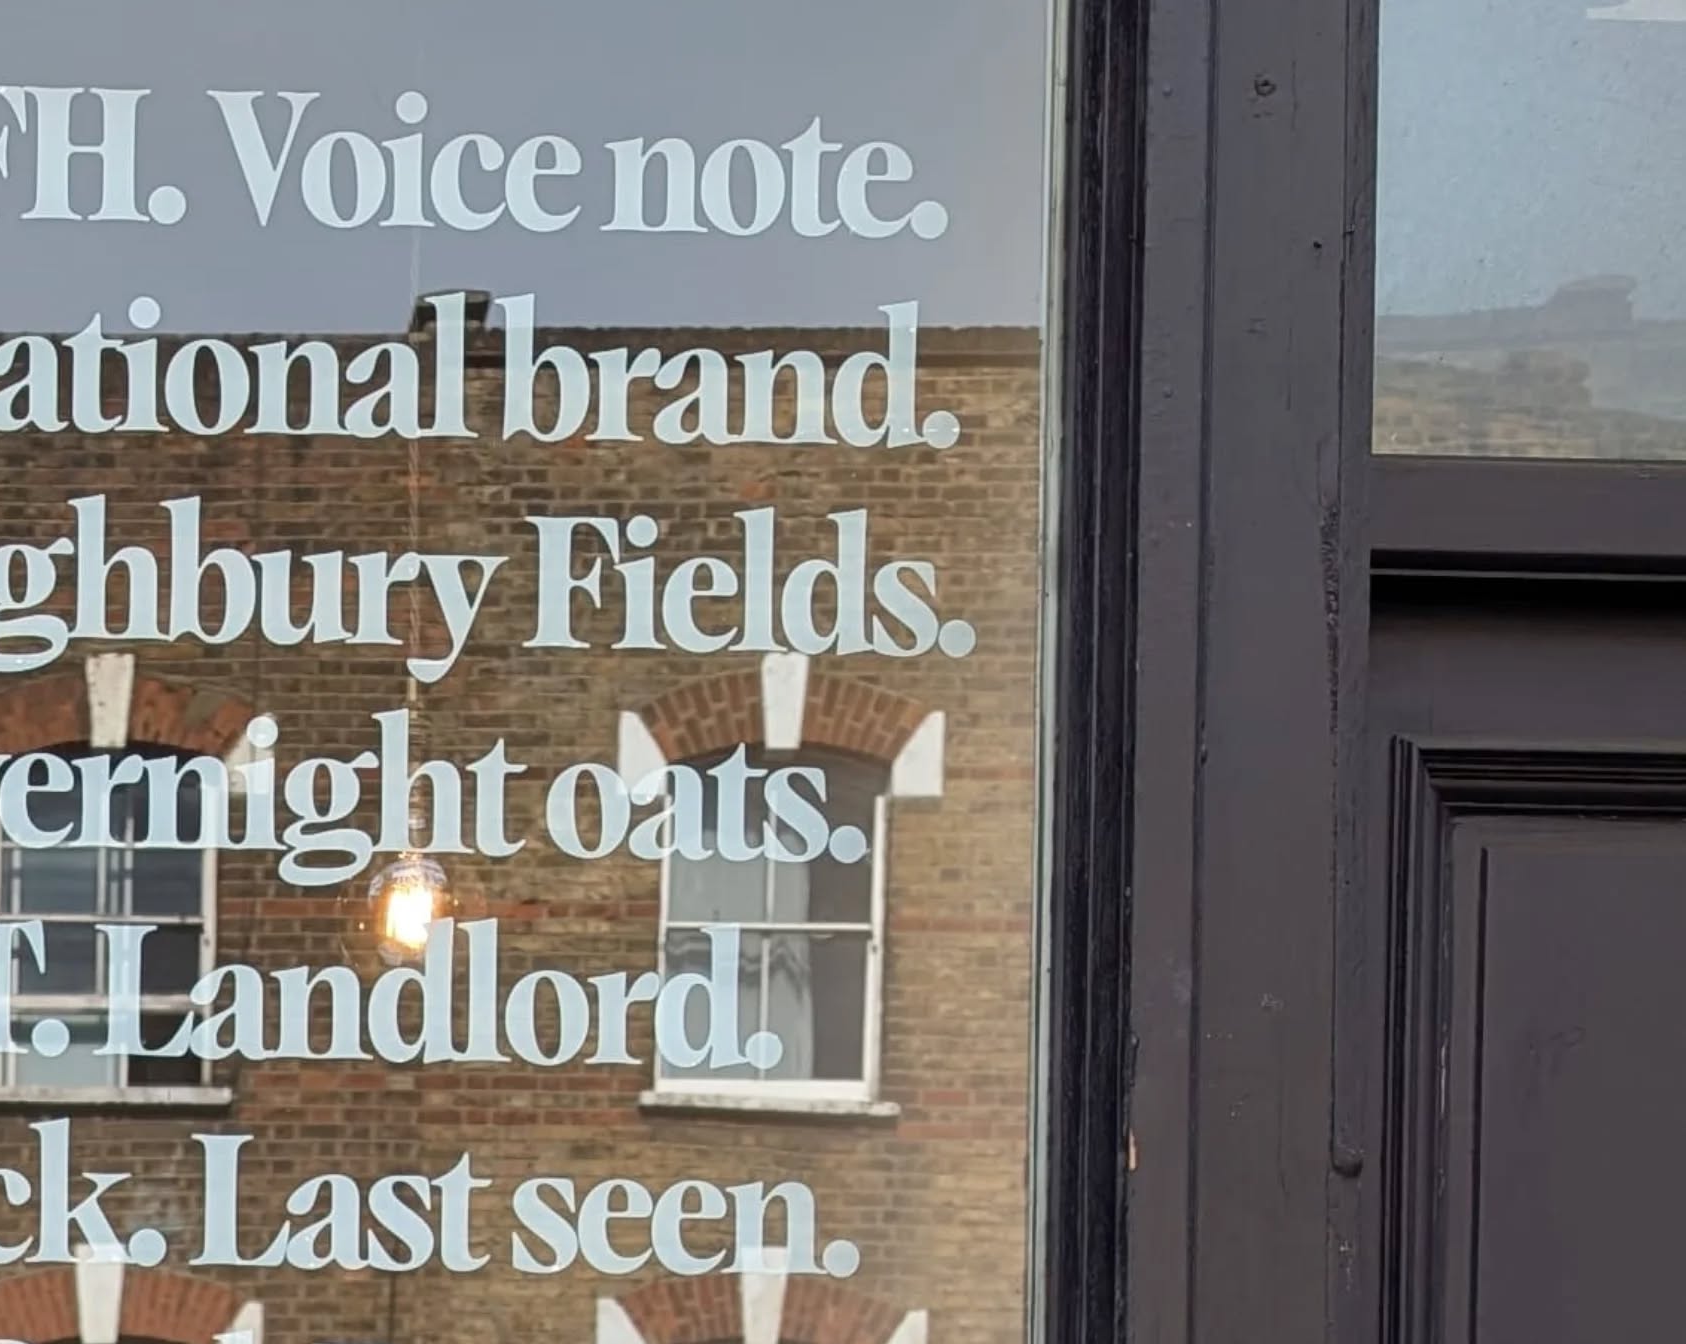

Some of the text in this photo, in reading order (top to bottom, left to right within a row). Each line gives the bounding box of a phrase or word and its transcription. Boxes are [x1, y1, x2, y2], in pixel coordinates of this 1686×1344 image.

[206, 90, 582, 231] Voice
[600, 116, 949, 240] note.
[488, 298, 960, 450] brand.
[523, 506, 976, 660] Fields.
[546, 742, 869, 865] oats.
[93, 916, 783, 1071] Landlord.
[190, 1133, 492, 1275] Last
[512, 1172, 861, 1280] seen.
